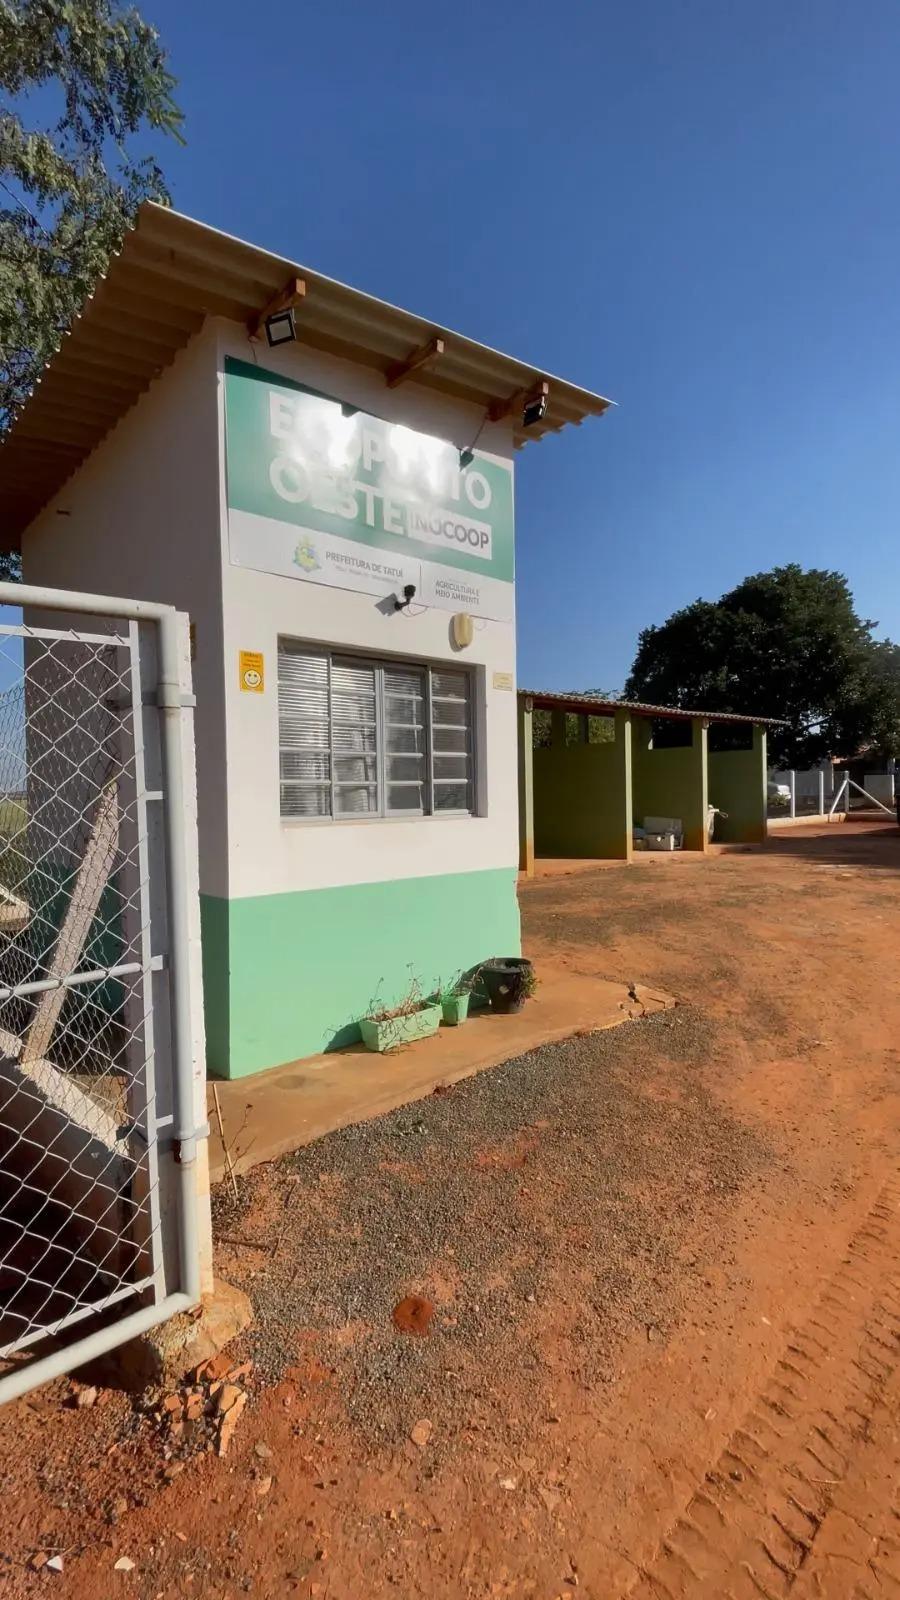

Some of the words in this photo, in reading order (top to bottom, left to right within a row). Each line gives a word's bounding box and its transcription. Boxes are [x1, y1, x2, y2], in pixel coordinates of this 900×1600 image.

[325, 551, 371, 571] PREFEITURA
[372, 562, 382, 573] DE
[383, 565, 404, 578] TATUÍ
[435, 580, 473, 595] AGRICULTURA
[435, 589, 450, 598] MEIO
[450, 592, 480, 605] AMBIENTE
